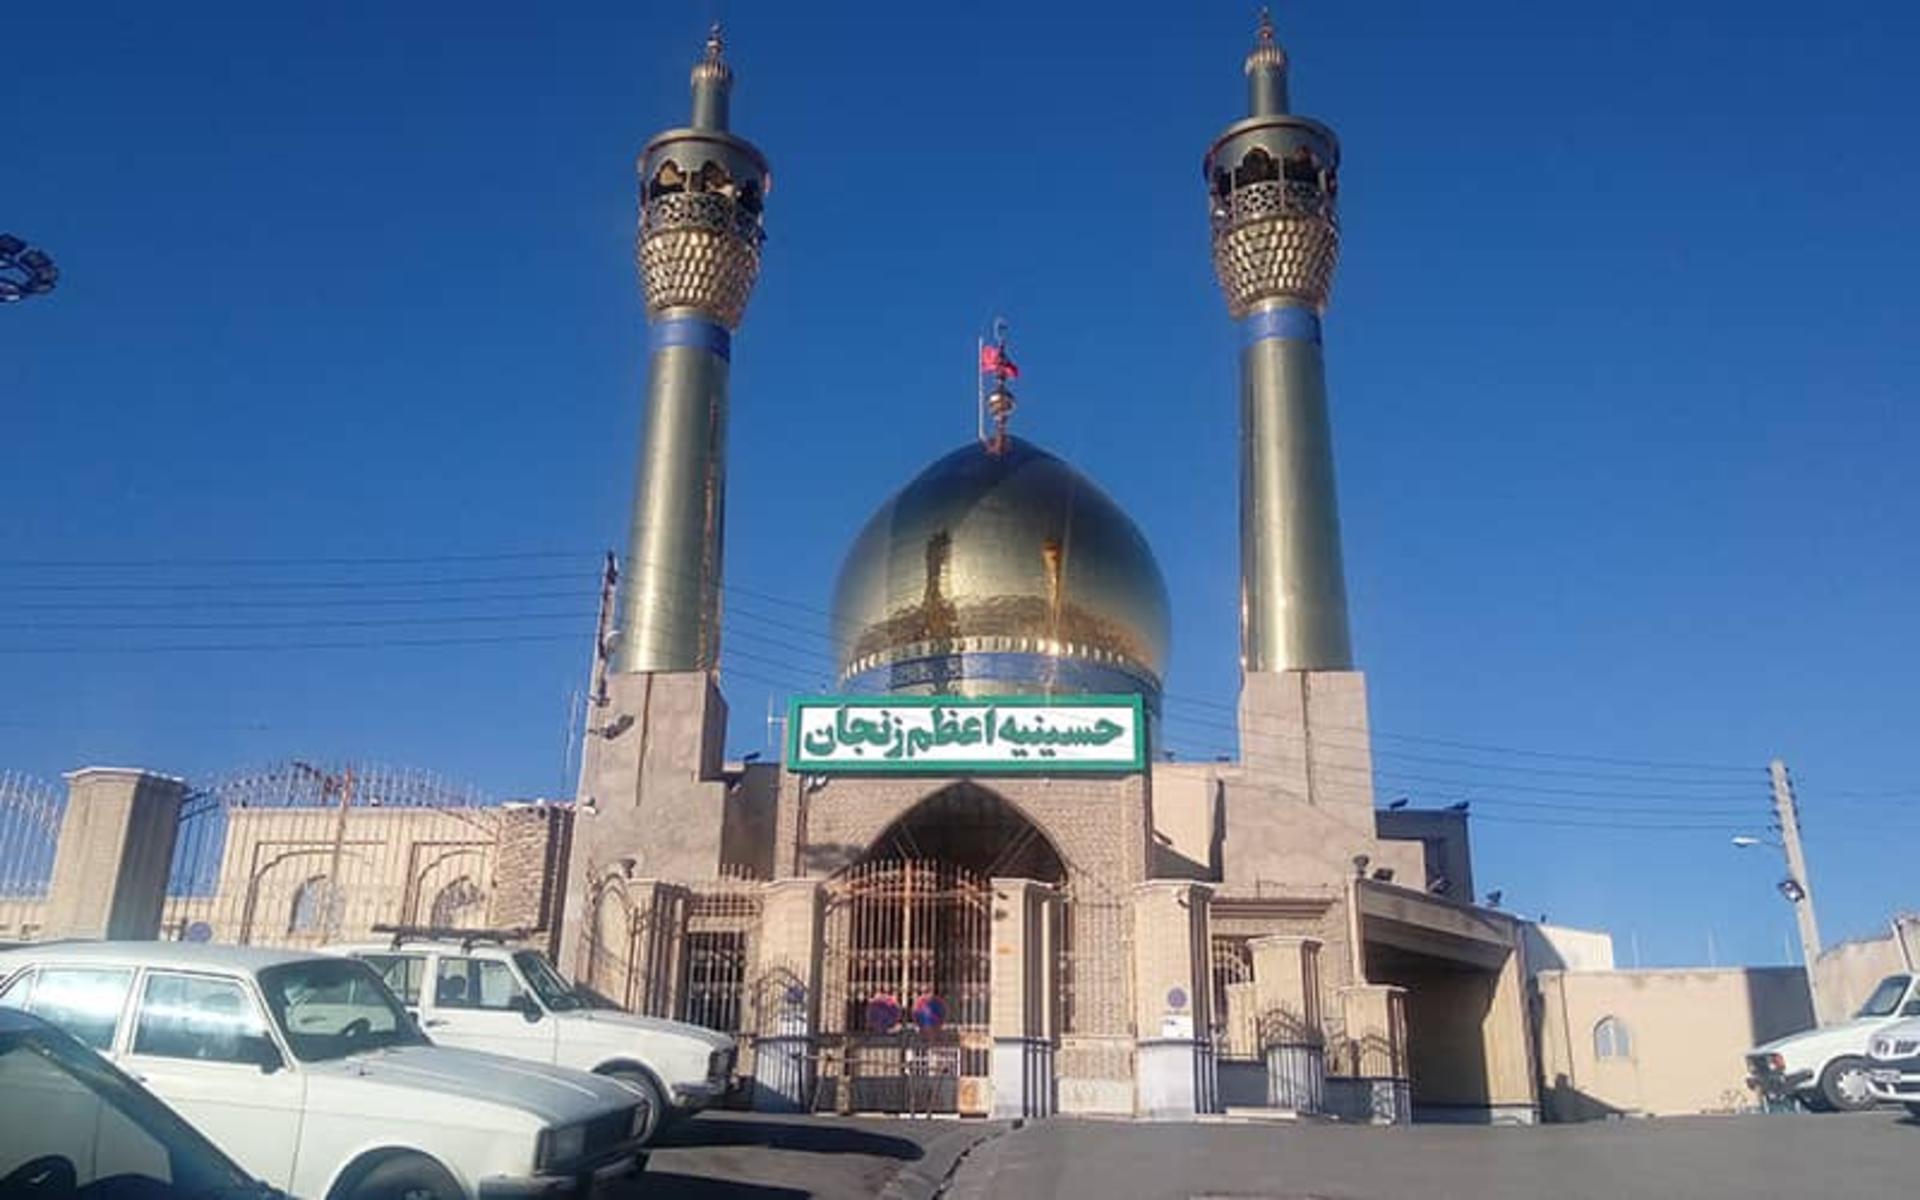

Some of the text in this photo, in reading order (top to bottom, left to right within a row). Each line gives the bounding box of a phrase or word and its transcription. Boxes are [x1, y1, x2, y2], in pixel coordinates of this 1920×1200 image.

[805, 704, 1124, 758] حسینیه اعظم زنجان
